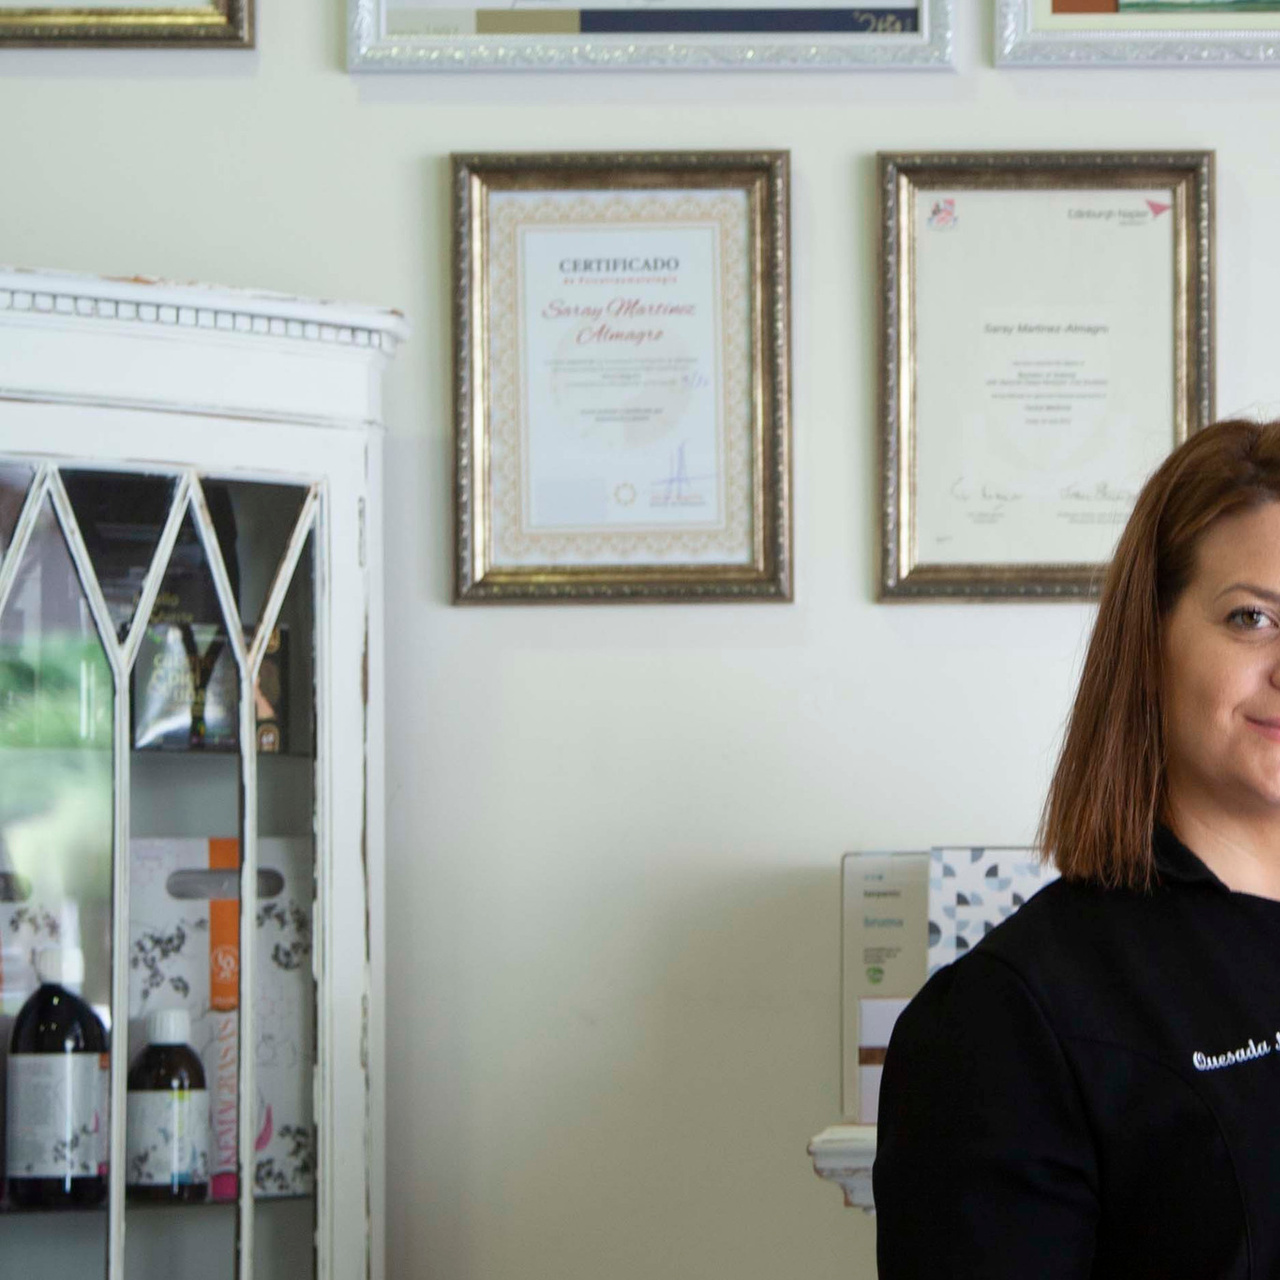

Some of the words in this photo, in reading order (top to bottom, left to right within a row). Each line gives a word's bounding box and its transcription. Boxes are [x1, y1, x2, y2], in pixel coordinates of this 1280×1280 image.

[558, 257, 680, 274] CERTIFICADO
[541, 297, 604, 321] Saray
[574, 322, 665, 347] Almagro
[1192, 1037, 1271, 1071] Quesada
